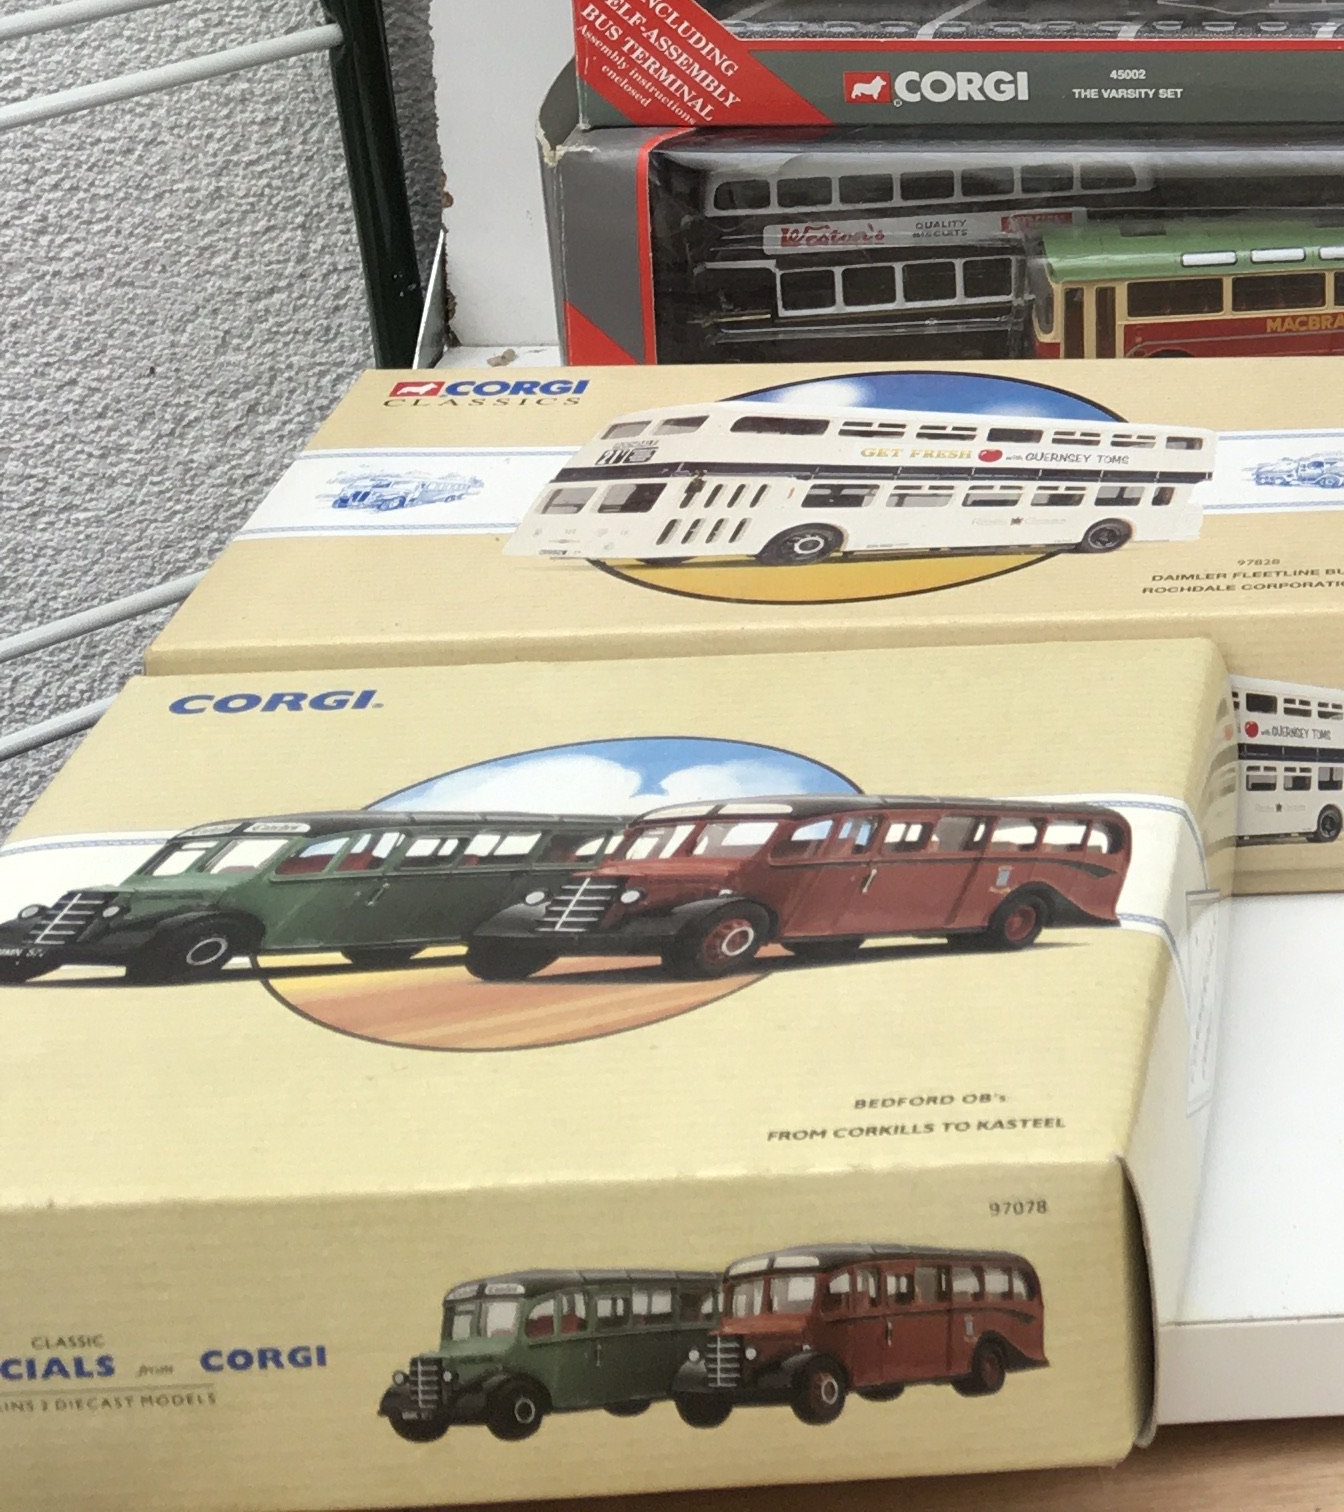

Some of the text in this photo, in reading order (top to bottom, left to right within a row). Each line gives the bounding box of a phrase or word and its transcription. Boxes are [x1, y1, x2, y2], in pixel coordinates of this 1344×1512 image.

[580, 4, 715, 123] BUS TERMINAL
[1110, 69, 1146, 80] 45002
[894, 71, 1029, 104] CORGI
[1073, 88, 1183, 100] THE VARSITY SET
[915, 220, 968, 231] QUALITY
[443, 379, 590, 397] CORGI
[383, 397, 583, 408] CLASSICS
[861, 447, 905, 460] GET
[910, 447, 973, 460] FRESH
[1025, 452, 1093, 464] GUERNSEY
[1096, 453, 1129, 465] TOMS
[1152, 570, 1228, 582] DAIMLER
[1233, 569, 1320, 580] FLEETLINE
[1142, 583, 1237, 594] ROCHDALE
[168, 690, 378, 715] CORGI
[854, 1092, 1007, 1110] BEDFORD OB's
[767, 1117, 1066, 1143] FROM CORKILLS TO KASTEEL
[989, 1200, 1047, 1215] 97078
[31, 1334, 105, 1350] CLASSIC
[56, 1392, 216, 1410] DIECAST MODELS
